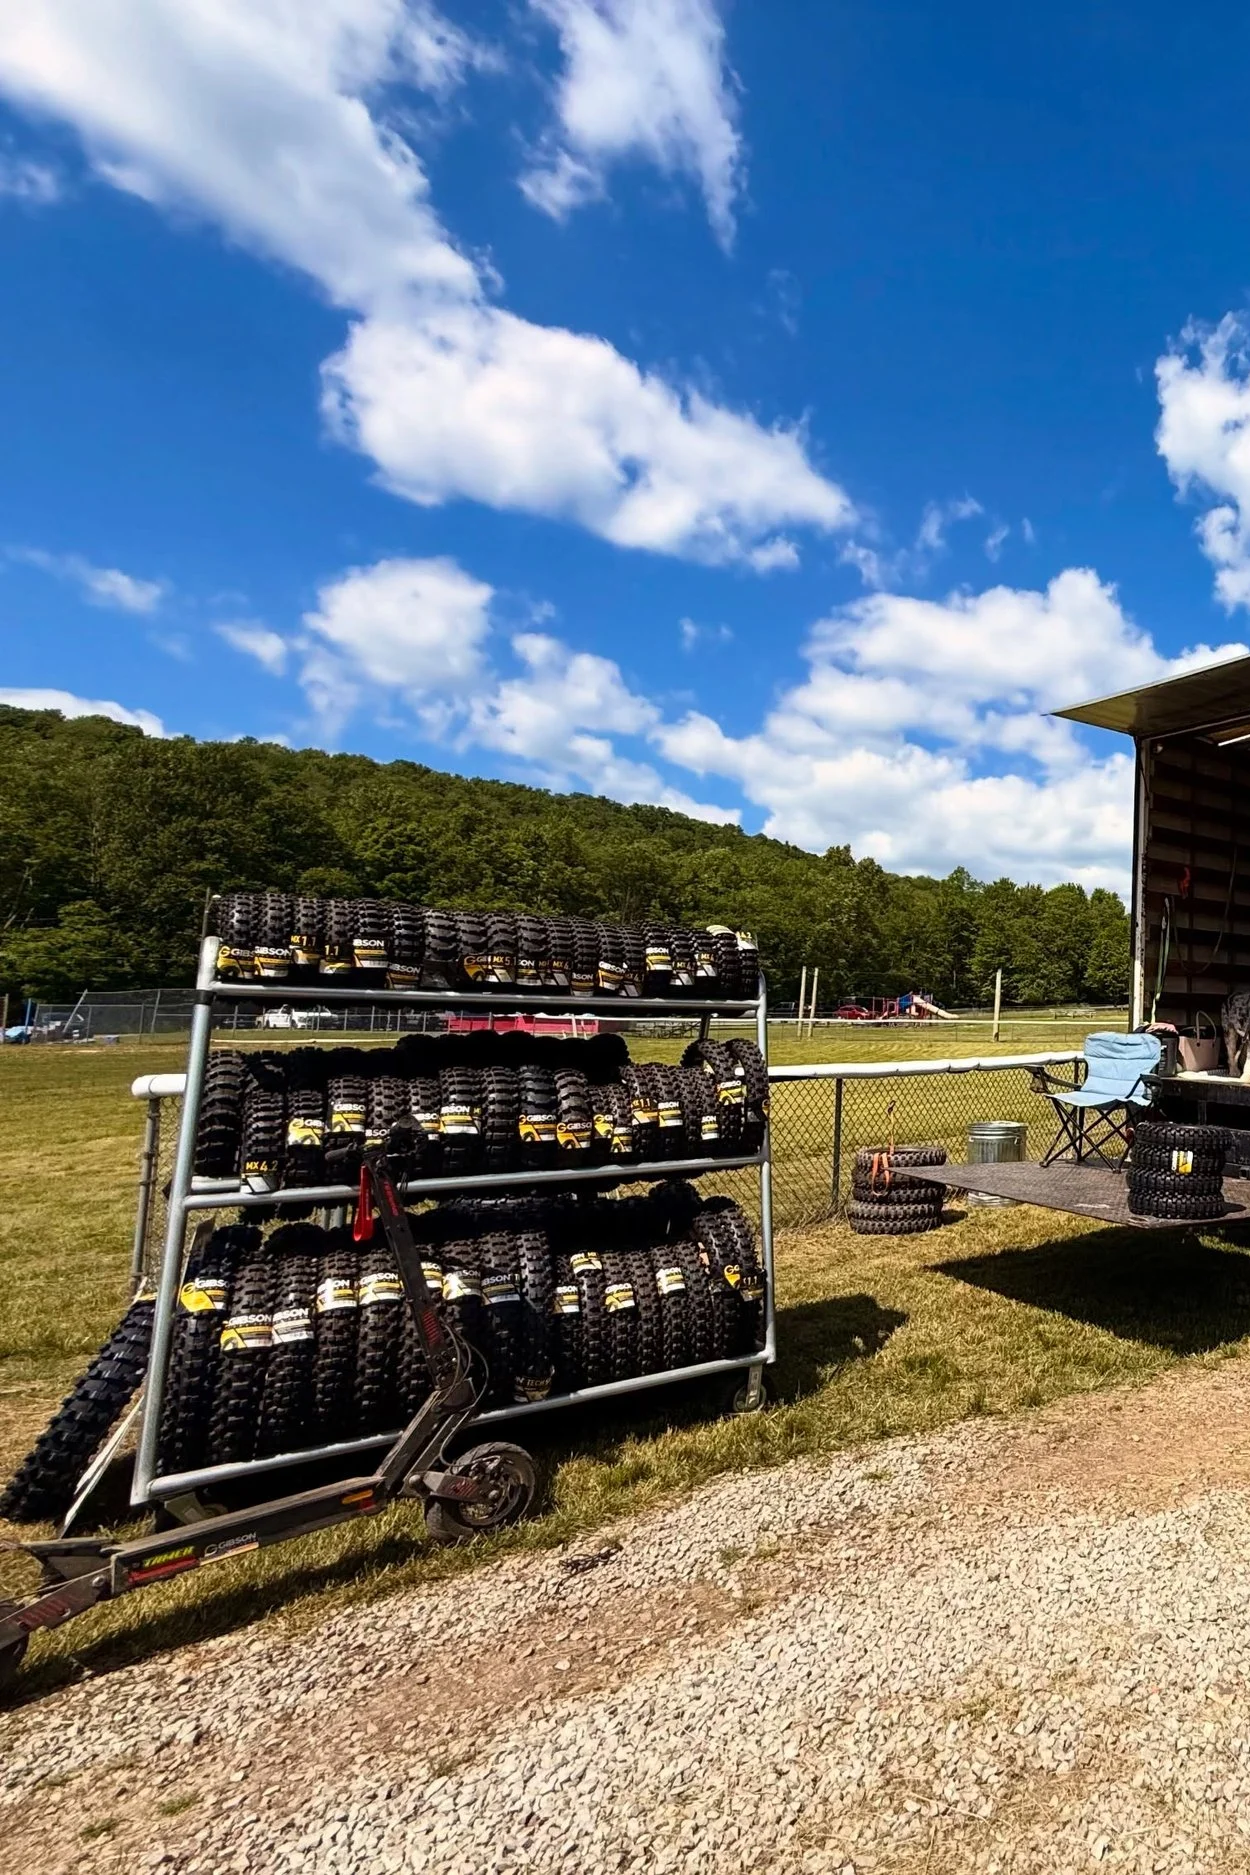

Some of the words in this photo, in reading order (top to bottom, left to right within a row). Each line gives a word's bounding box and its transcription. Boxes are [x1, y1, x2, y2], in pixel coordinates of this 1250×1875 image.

[325, 944, 339, 956] 1.1
[246, 1162, 258, 1170] MX
[218, 1532, 257, 1549] GIBSON
